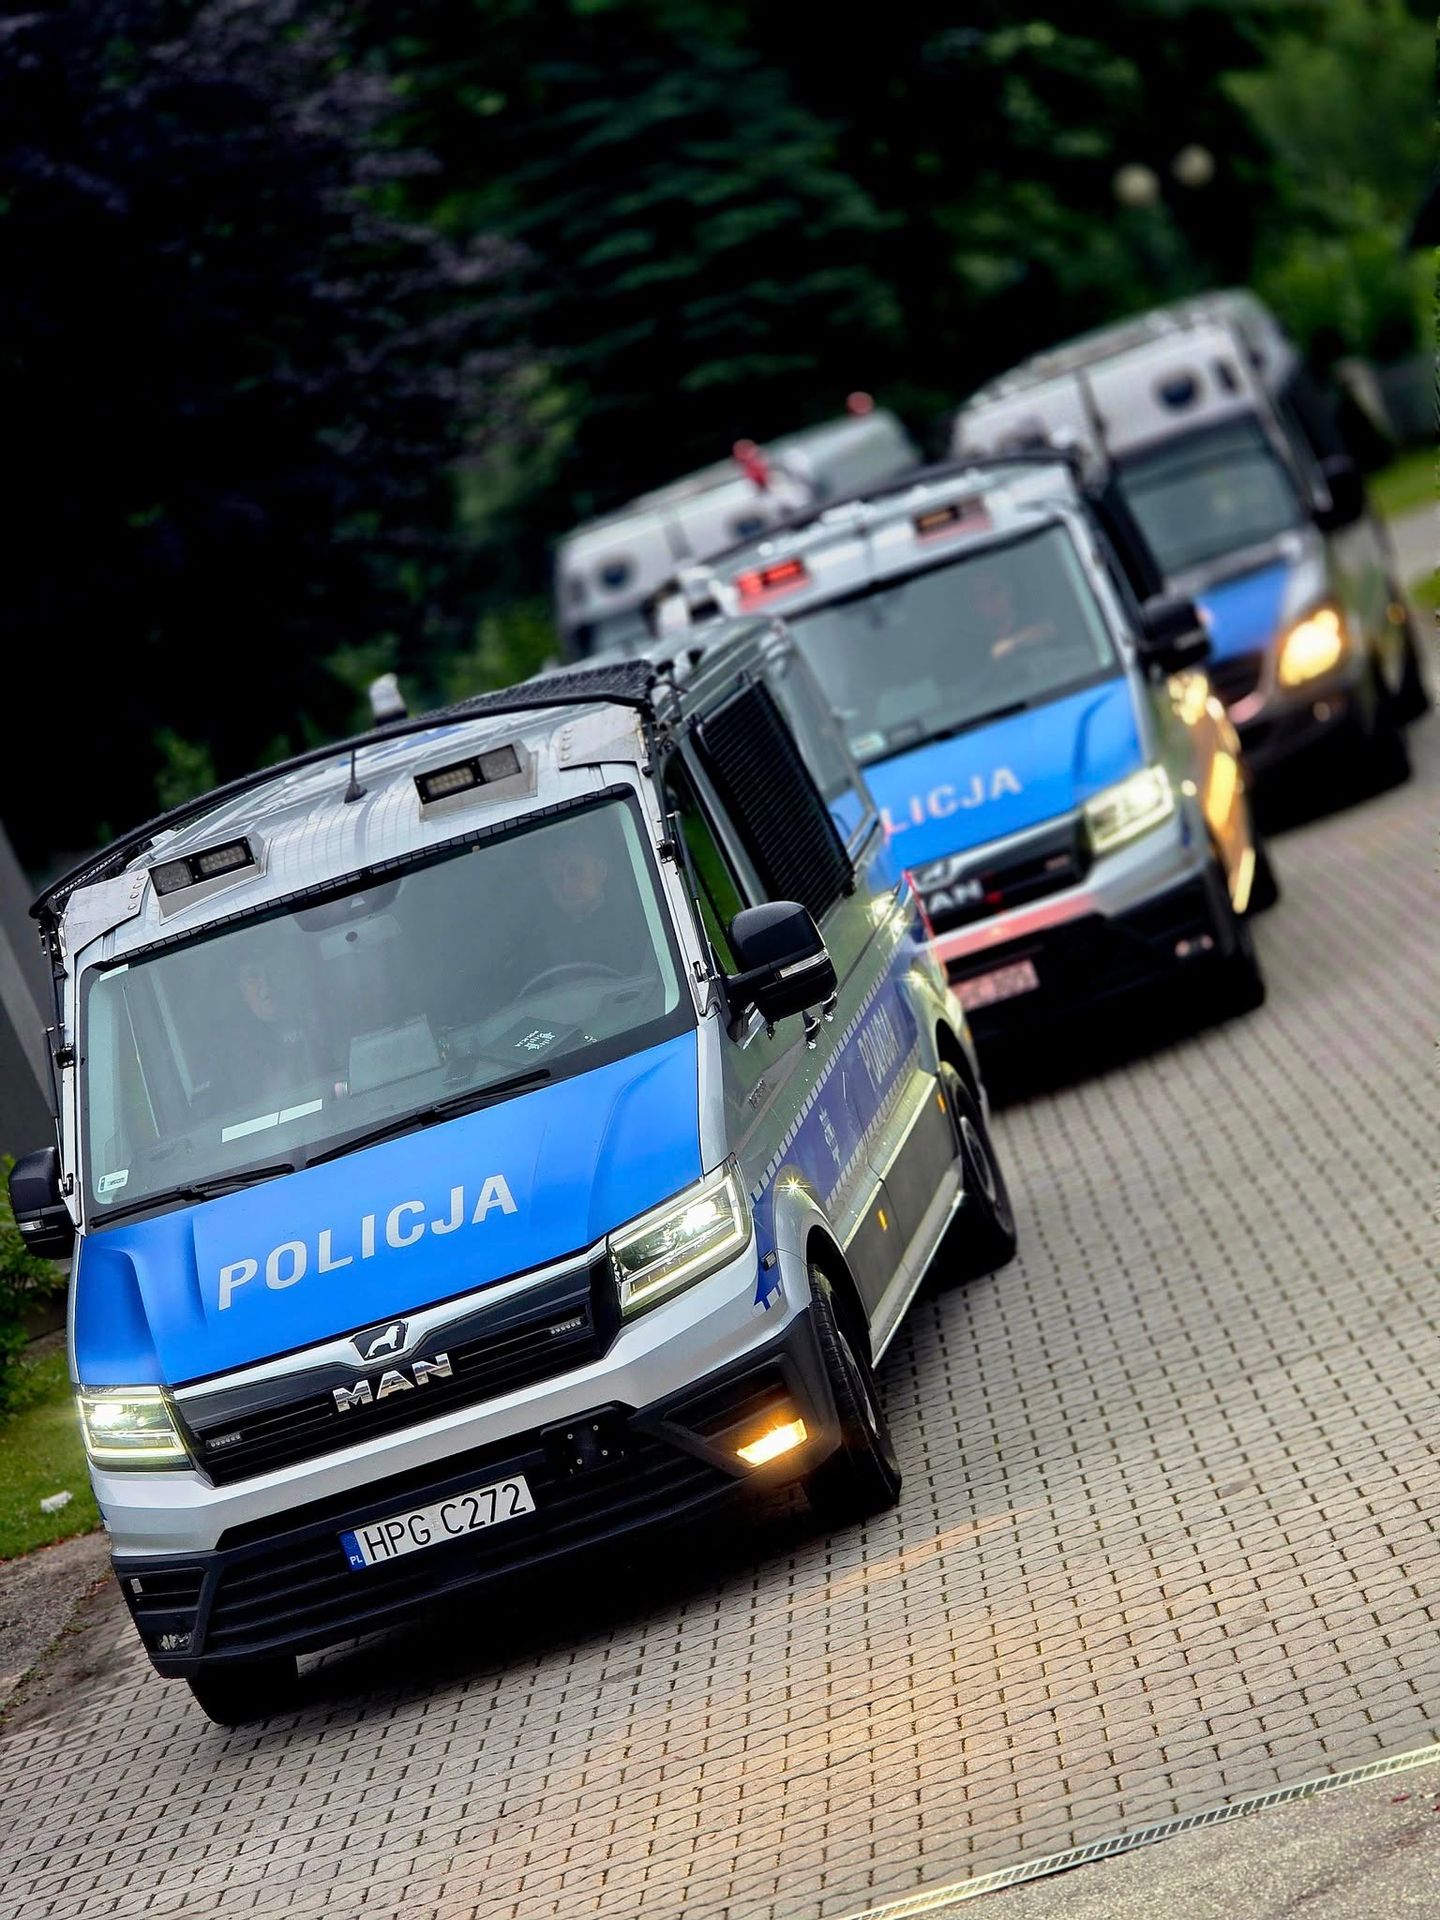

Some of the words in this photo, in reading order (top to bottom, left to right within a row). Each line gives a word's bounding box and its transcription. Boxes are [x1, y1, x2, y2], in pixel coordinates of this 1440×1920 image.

[879, 767, 1022, 834] LICJA
[928, 878, 984, 914] AN
[857, 1003, 900, 1093] POLICJA
[218, 1174, 518, 1311] POLICJA
[332, 1352, 453, 1413] MAN
[362, 1514, 432, 1561] HPG
[440, 1483, 527, 1535] C272
[350, 1555, 363, 1566] PL
